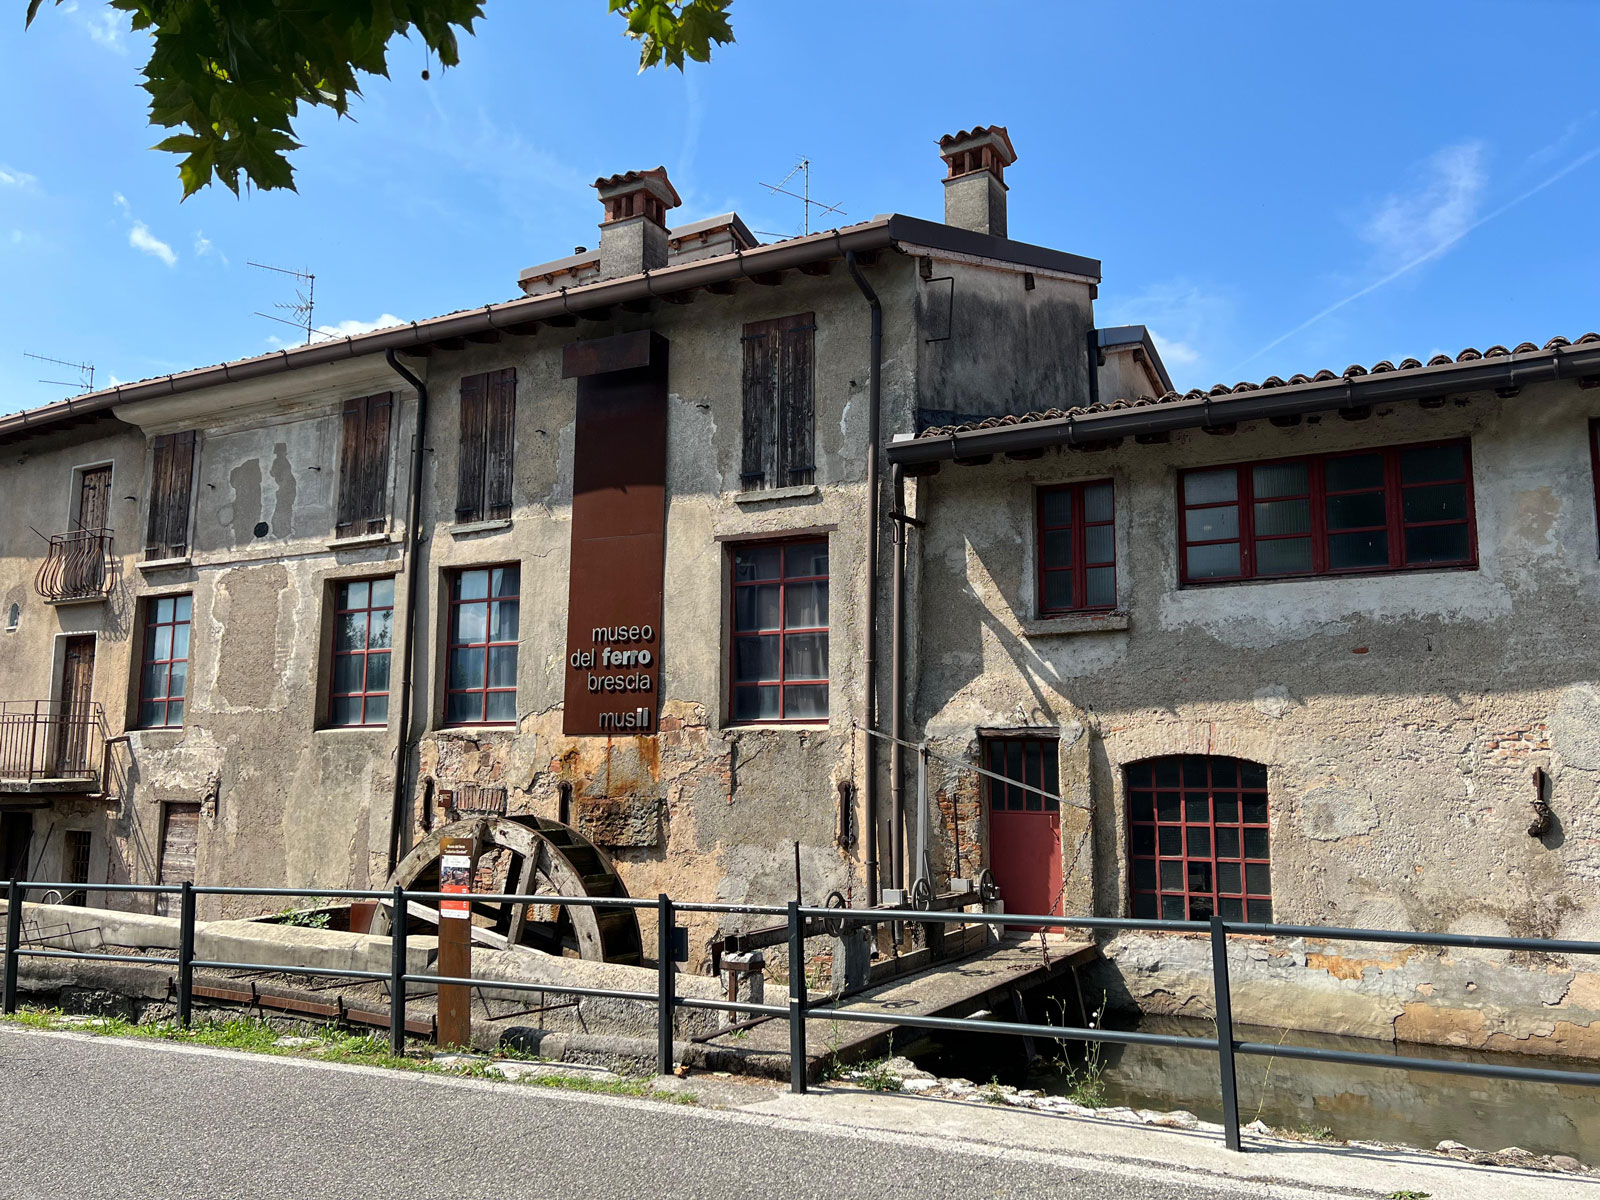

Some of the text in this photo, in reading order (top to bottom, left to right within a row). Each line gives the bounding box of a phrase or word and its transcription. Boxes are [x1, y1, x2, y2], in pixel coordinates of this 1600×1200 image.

[592, 625, 653, 642] museo
[570, 647, 651, 667] del ferro
[588, 672, 650, 690] brescia
[599, 707, 649, 728] musil
